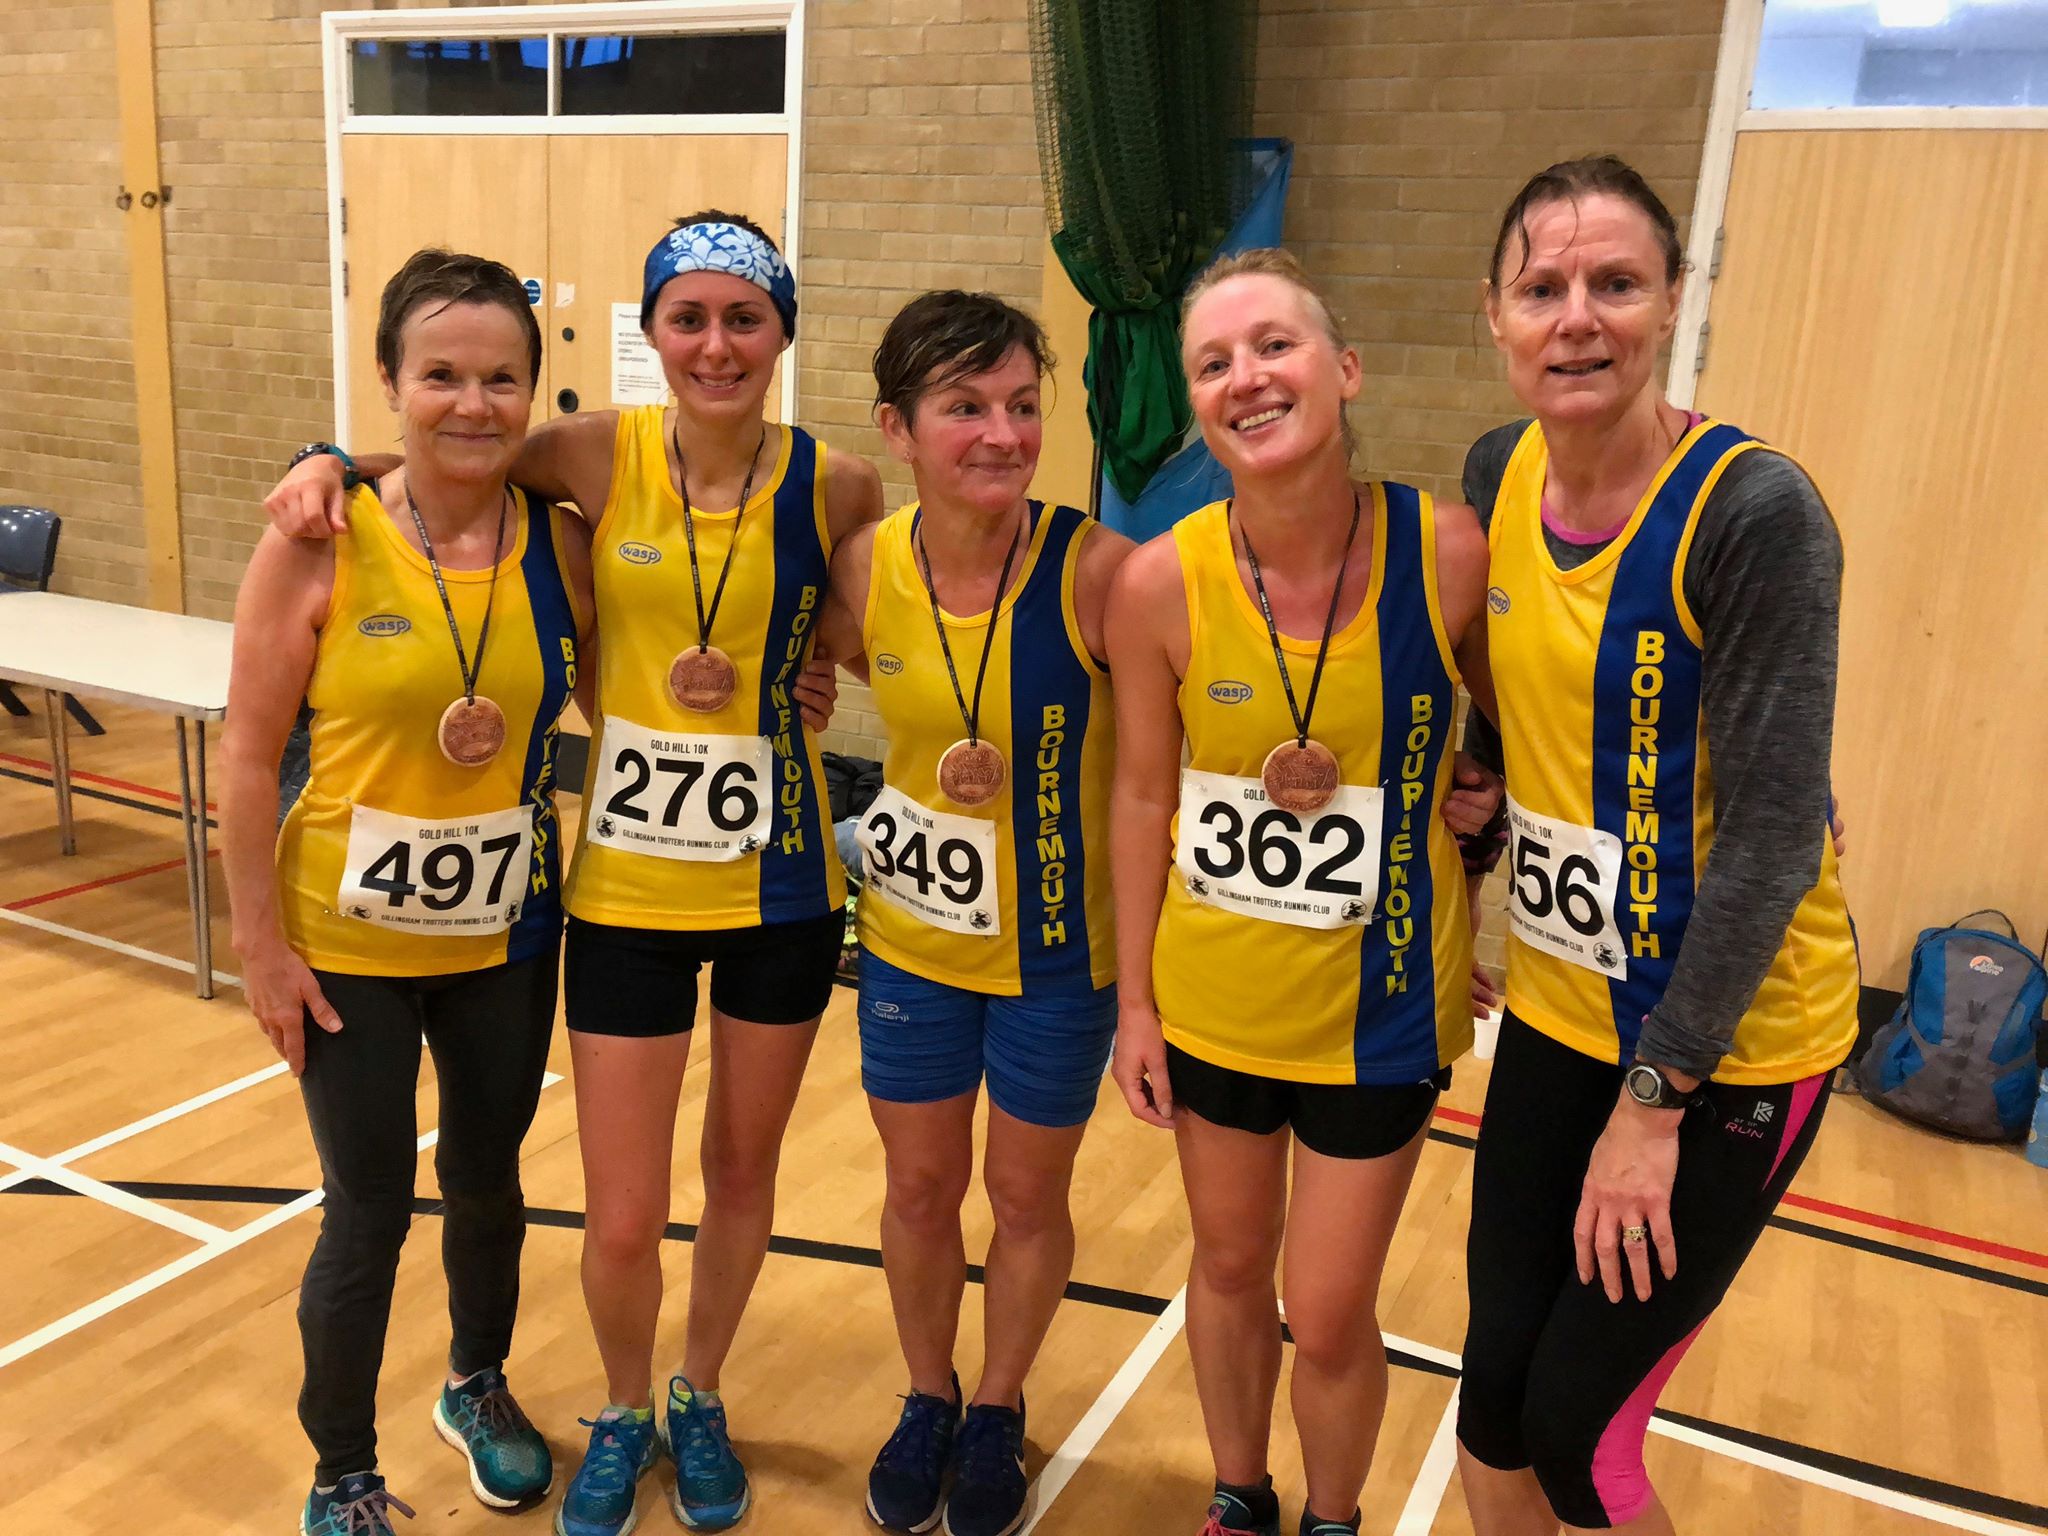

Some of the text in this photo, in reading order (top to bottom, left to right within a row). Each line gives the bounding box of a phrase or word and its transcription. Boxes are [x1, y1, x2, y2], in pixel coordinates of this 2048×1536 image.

[621, 545, 659, 563] wasp
[361, 618, 408, 635] wasp
[878, 657, 901, 672] wasp
[1211, 686, 1250, 702] wasp
[771, 585, 817, 855] BOURNEMOUTH
[651, 739, 709, 755] GOLD HILL 10K
[605, 748, 759, 832] 276
[1243, 788, 1265, 801] GOLD
[1625, 630, 1665, 959] BOURNEMOUTH
[419, 825, 479, 840] GOLD HILL 10K
[922, 817, 934, 830] 10K
[1037, 704, 1067, 947] BOURNEMOUTH
[1524, 820, 1537, 836] HILL
[1539, 826, 1553, 840] 10K
[622, 829, 730, 849] GILLINGHAM TROTTERS RUNNING CLUB
[1194, 801, 1365, 896] 362
[868, 812, 983, 904] 349
[359, 832, 521, 910] 497
[1508, 826, 1605, 936] 56
[1217, 888, 1330, 915] GILLINGHAM TROTTERS RUNNING CLUB
[381, 914, 497, 927] GILLINGHAM TROTTERS RUNNING CLUB
[947, 911, 961, 921] CLUB
[1546, 931, 1568, 947] RUNNING
[1569, 939, 1584, 953] CLUB
[1725, 1121, 1764, 1139] RUN
